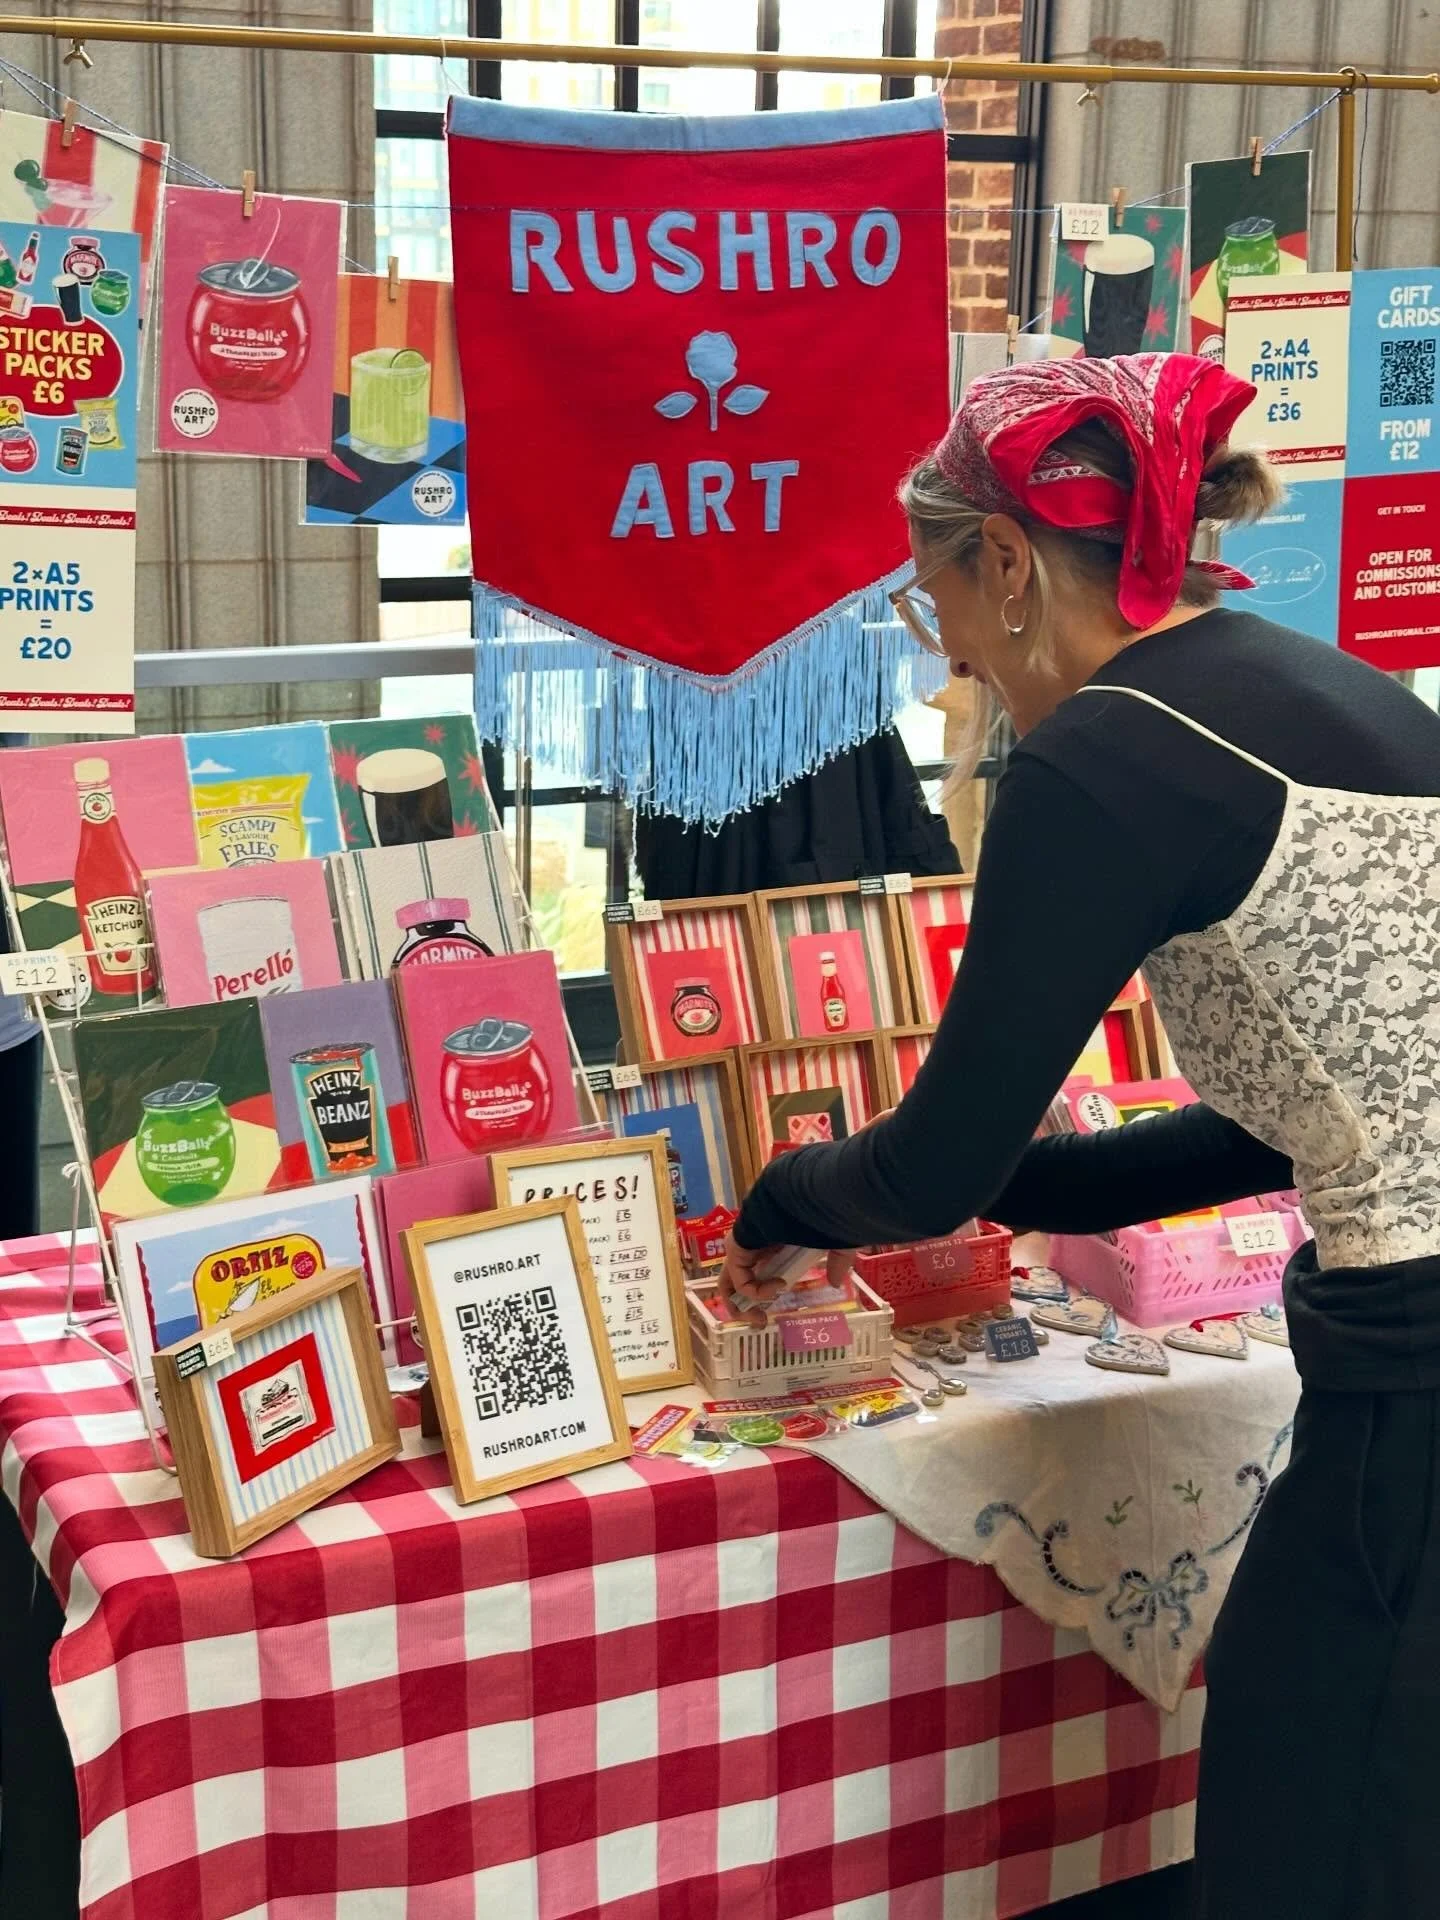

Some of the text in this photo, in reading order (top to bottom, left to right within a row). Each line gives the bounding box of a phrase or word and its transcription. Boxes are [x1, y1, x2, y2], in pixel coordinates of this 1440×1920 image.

[1072, 219, 1100, 235] £12
[510, 207, 901, 294] RUSHRO
[1390, 285, 1433, 307] GIFT
[1378, 307, 1440, 329] CARDS
[0, 327, 105, 356] STICKER
[5, 352, 92, 381] PACKS
[1251, 361, 1319, 382] PRINTS
[32, 380, 66, 405] £6
[174, 404, 216, 417] RUSHRO
[184, 415, 206, 425] ART
[1267, 402, 1302, 423] £36
[1380, 419, 1432, 441] FROM
[1390, 441, 1421, 461] £12
[414, 486, 453, 496] RUSHRO
[423, 495, 444, 504] ART
[609, 459, 800, 540] ART
[1377, 506, 1393, 516] GET
[1402, 504, 1426, 513] TOUCH
[1368, 548, 1433, 566] OPEN FOR
[1356, 563, 1440, 584] COMMISSIONS
[0, 588, 94, 612] PRINTS
[1353, 580, 1440, 601] AND CUSTOMS
[20, 637, 72, 660] £20
[219, 819, 277, 838] SCAMPI
[219, 841, 280, 862] FRIES
[98, 904, 136, 918] HEINZ
[95, 919, 144, 934] KETCHUP
[15, 967, 58, 987] £12
[213, 948, 294, 1002] Perelló
[312, 1071, 361, 1095] HEINZ
[316, 1100, 371, 1126] BEANZ
[524, 1175, 639, 1203] PRICES!
[1243, 1229, 1276, 1249] £12
[211, 1245, 290, 1283] ORTIZ
[454, 1254, 541, 1284] @RUSHRO.ART
[932, 1251, 956, 1270] £6
[785, 1315, 840, 1327] STICKER PACK
[208, 1336, 229, 1357] £65
[803, 1327, 830, 1345] £6
[1000, 1339, 1031, 1357] £18
[483, 1420, 587, 1459] RUSHROART.COM
